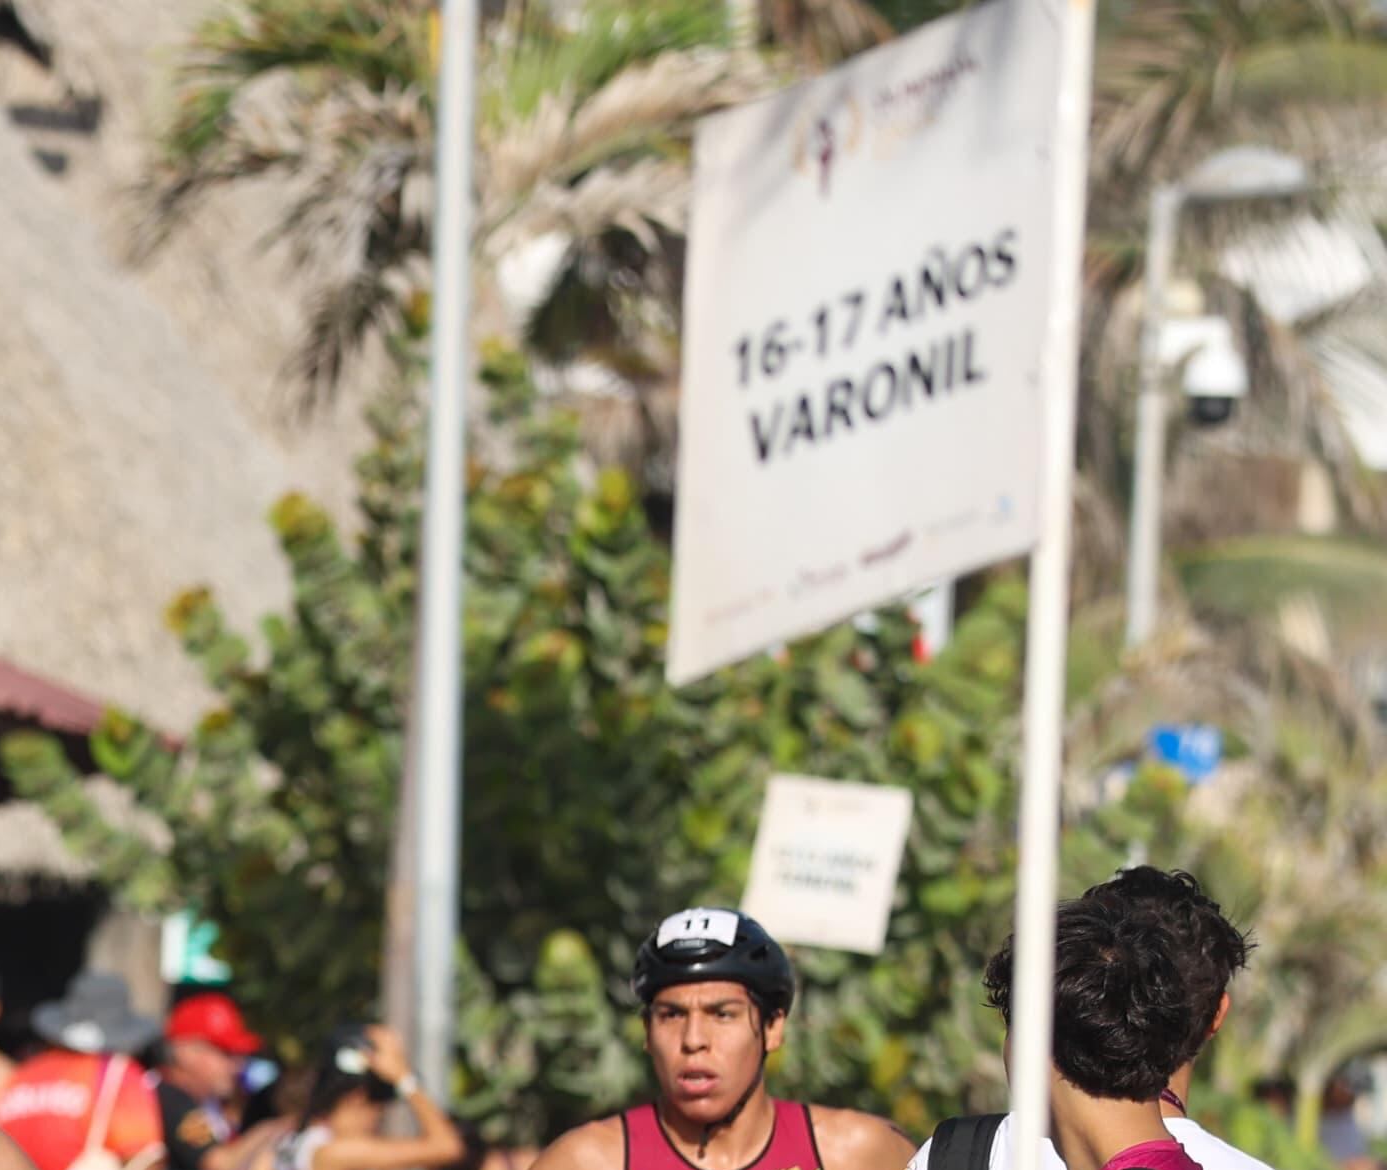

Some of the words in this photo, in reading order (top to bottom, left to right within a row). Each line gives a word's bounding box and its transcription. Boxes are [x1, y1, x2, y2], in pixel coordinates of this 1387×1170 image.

[731, 292, 868, 389] 16-17
[878, 227, 1020, 332] AÑOS
[747, 328, 988, 467] VARONIL
[685, 918, 710, 930] 11
